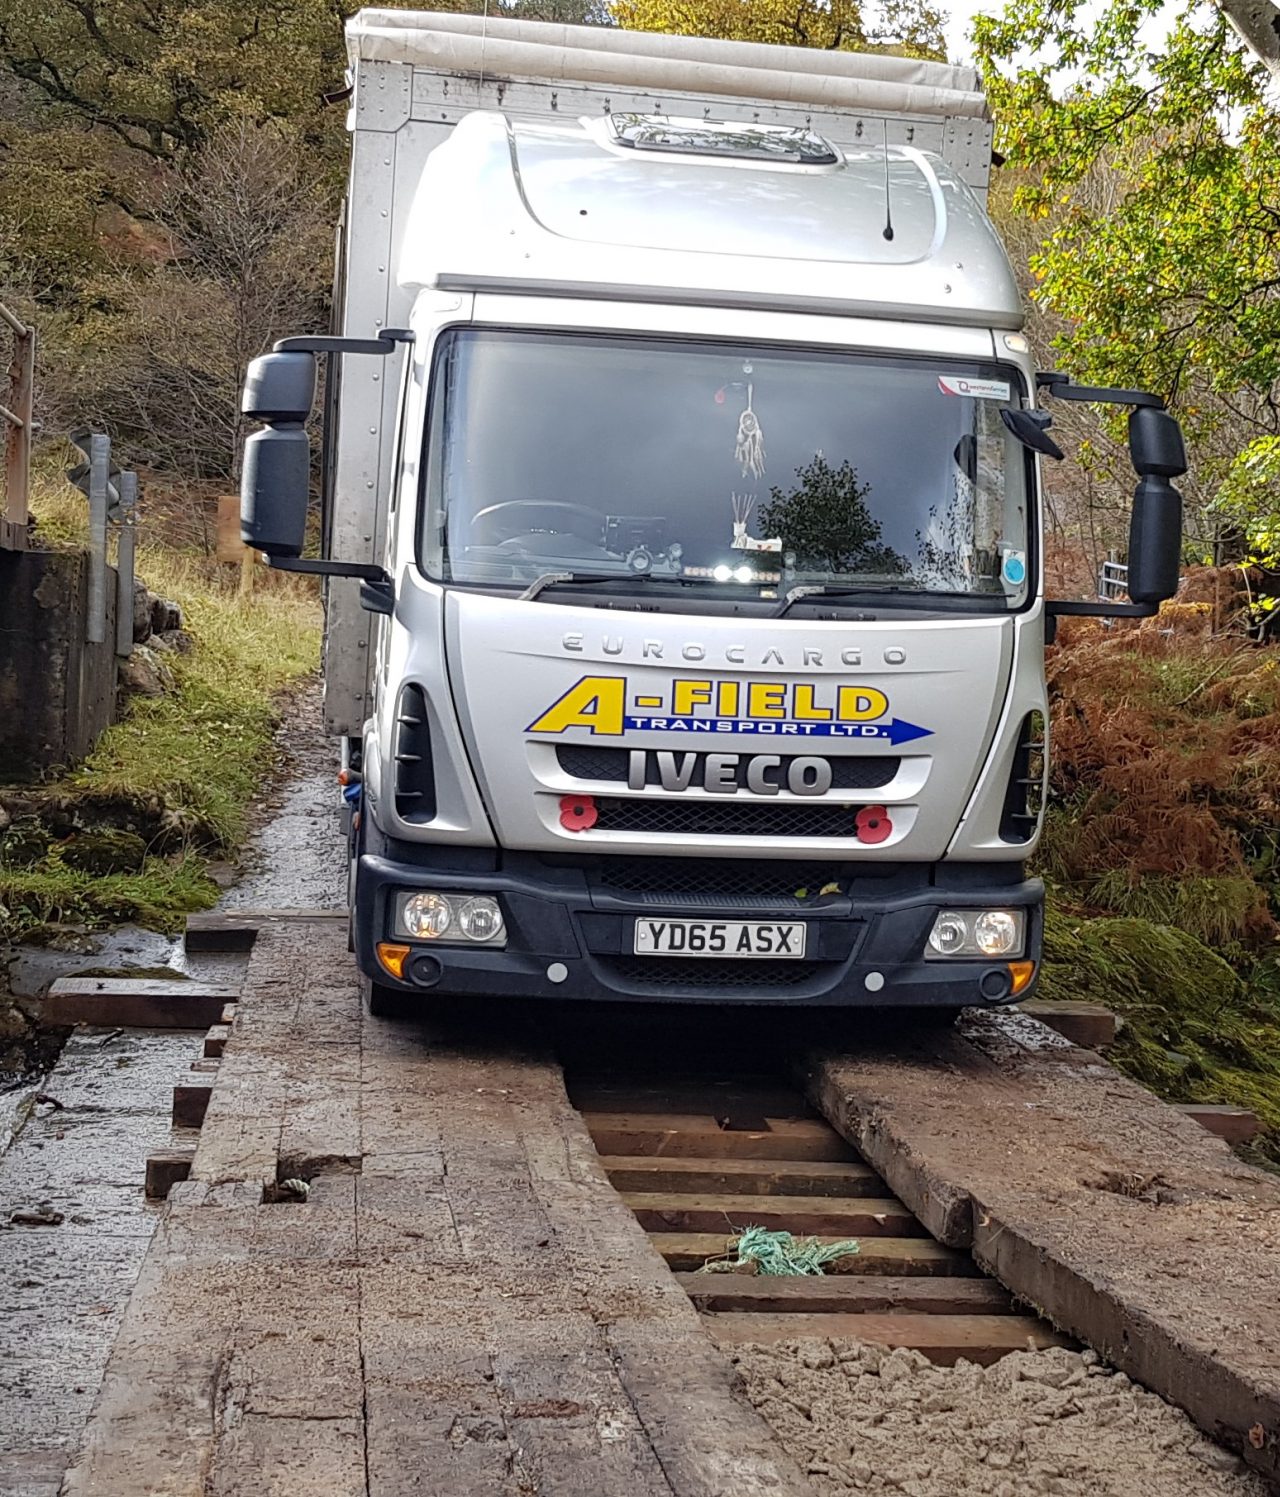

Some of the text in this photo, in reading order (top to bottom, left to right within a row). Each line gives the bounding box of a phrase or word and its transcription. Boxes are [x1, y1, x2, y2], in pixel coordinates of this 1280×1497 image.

[562, 632, 908, 666] EUROCARGO
[523, 675, 890, 735] A-FIELD
[631, 717, 889, 737] TRANSPORT LTD.
[627, 749, 833, 796] IVECO
[648, 923, 794, 953] YD65 ASX
